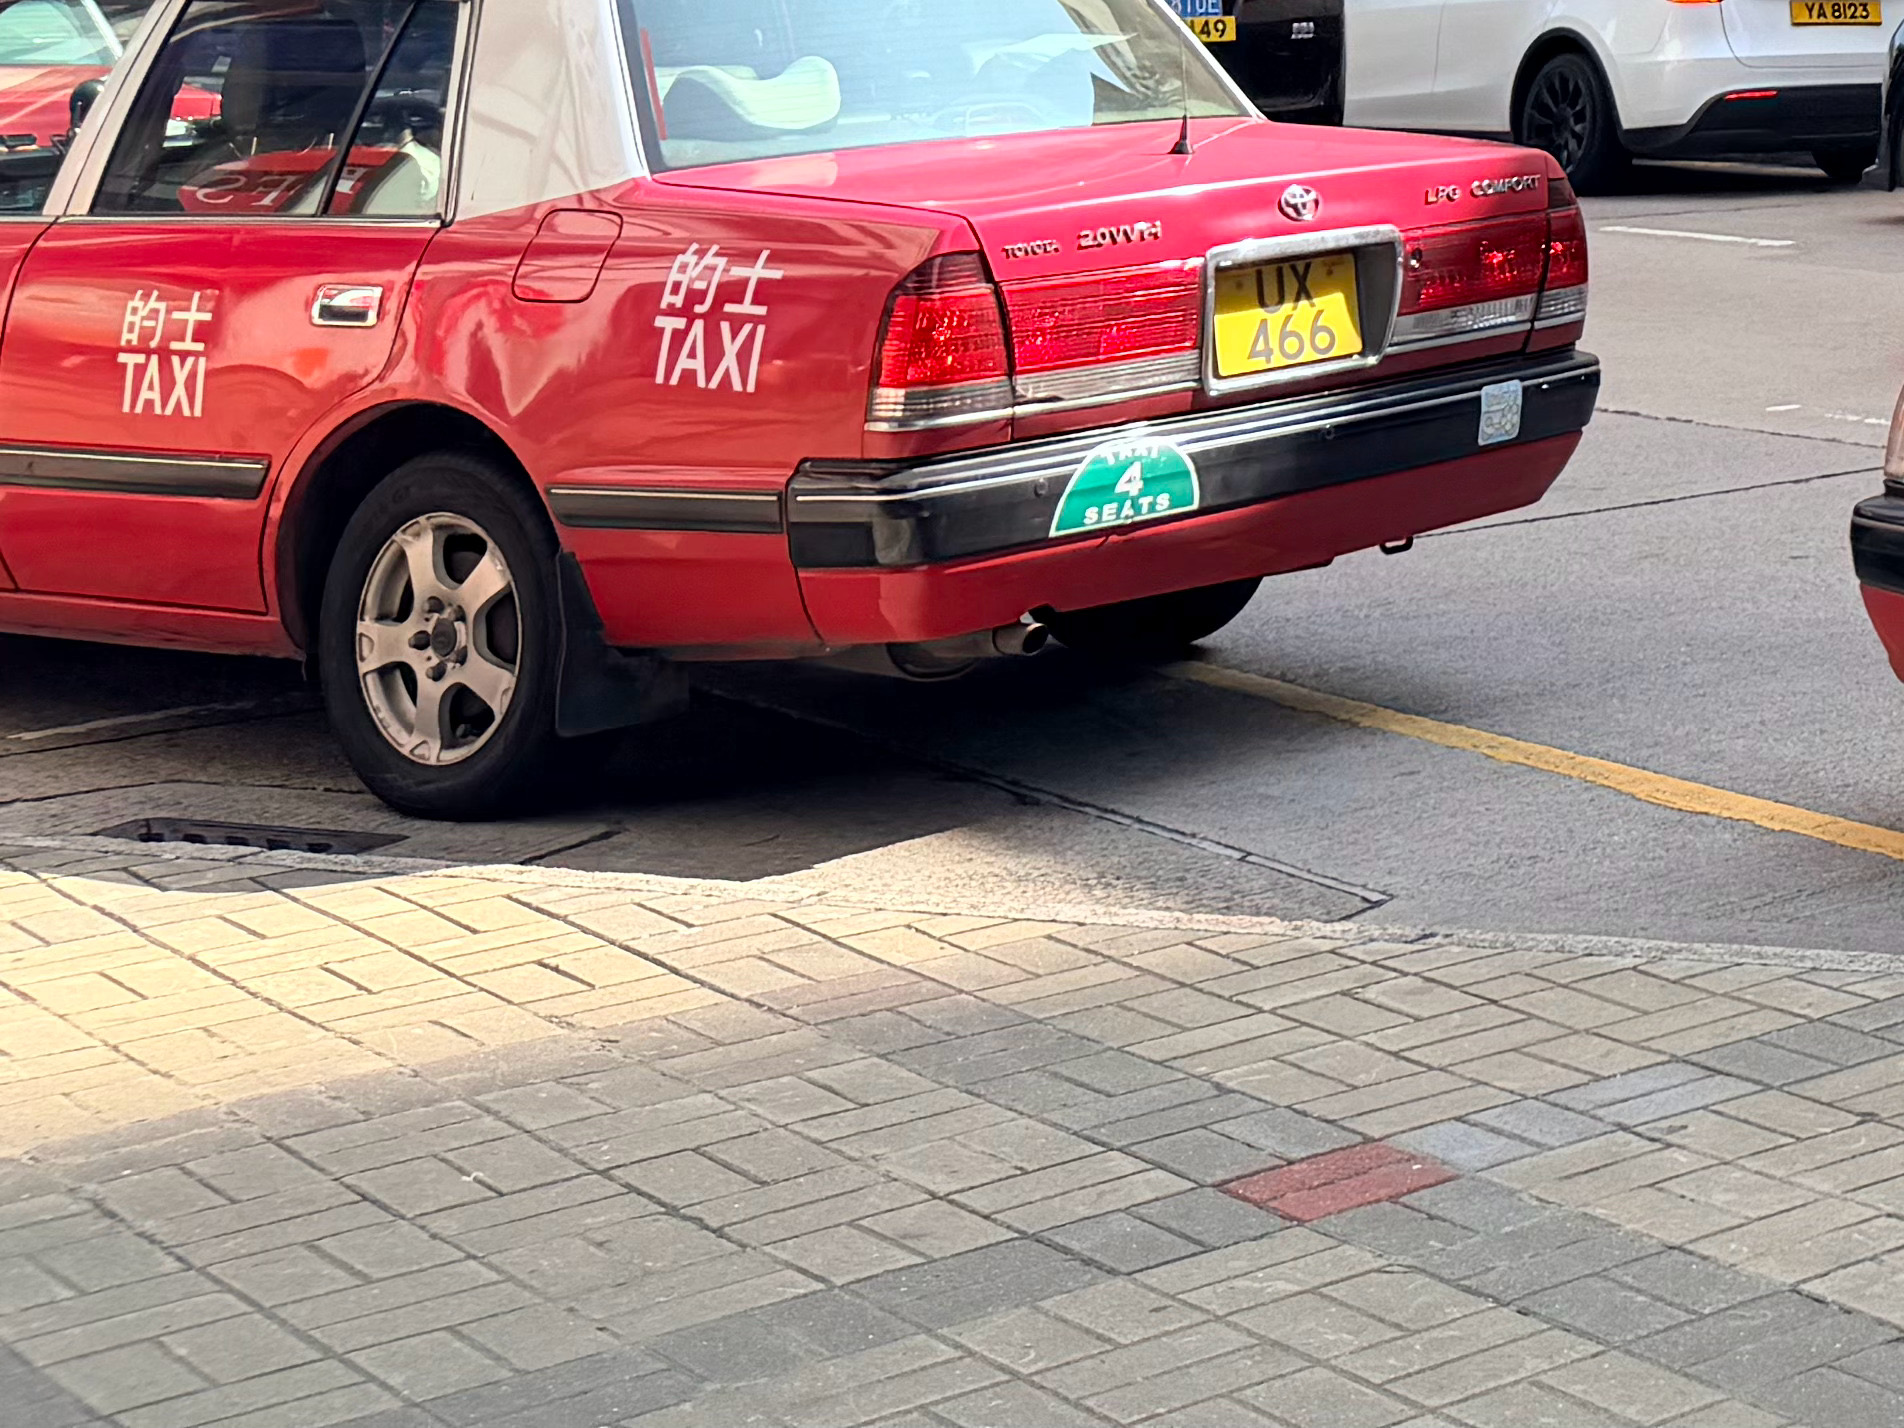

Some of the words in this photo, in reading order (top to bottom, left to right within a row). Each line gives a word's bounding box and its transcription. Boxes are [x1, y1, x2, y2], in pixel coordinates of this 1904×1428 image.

[1804, 2, 1828, 19] YA
[1831, 2, 1870, 19] 8123
[1424, 185, 1461, 206] LPG
[660, 242, 785, 316] 的士
[1255, 261, 1316, 314] UX
[120, 289, 213, 351] 的士
[1247, 309, 1336, 365] 466
[654, 315, 766, 393] TAXI
[117, 352, 207, 418] TAXI
[1114, 461, 1144, 497] 4
[1083, 493, 1170, 526] SEATS
